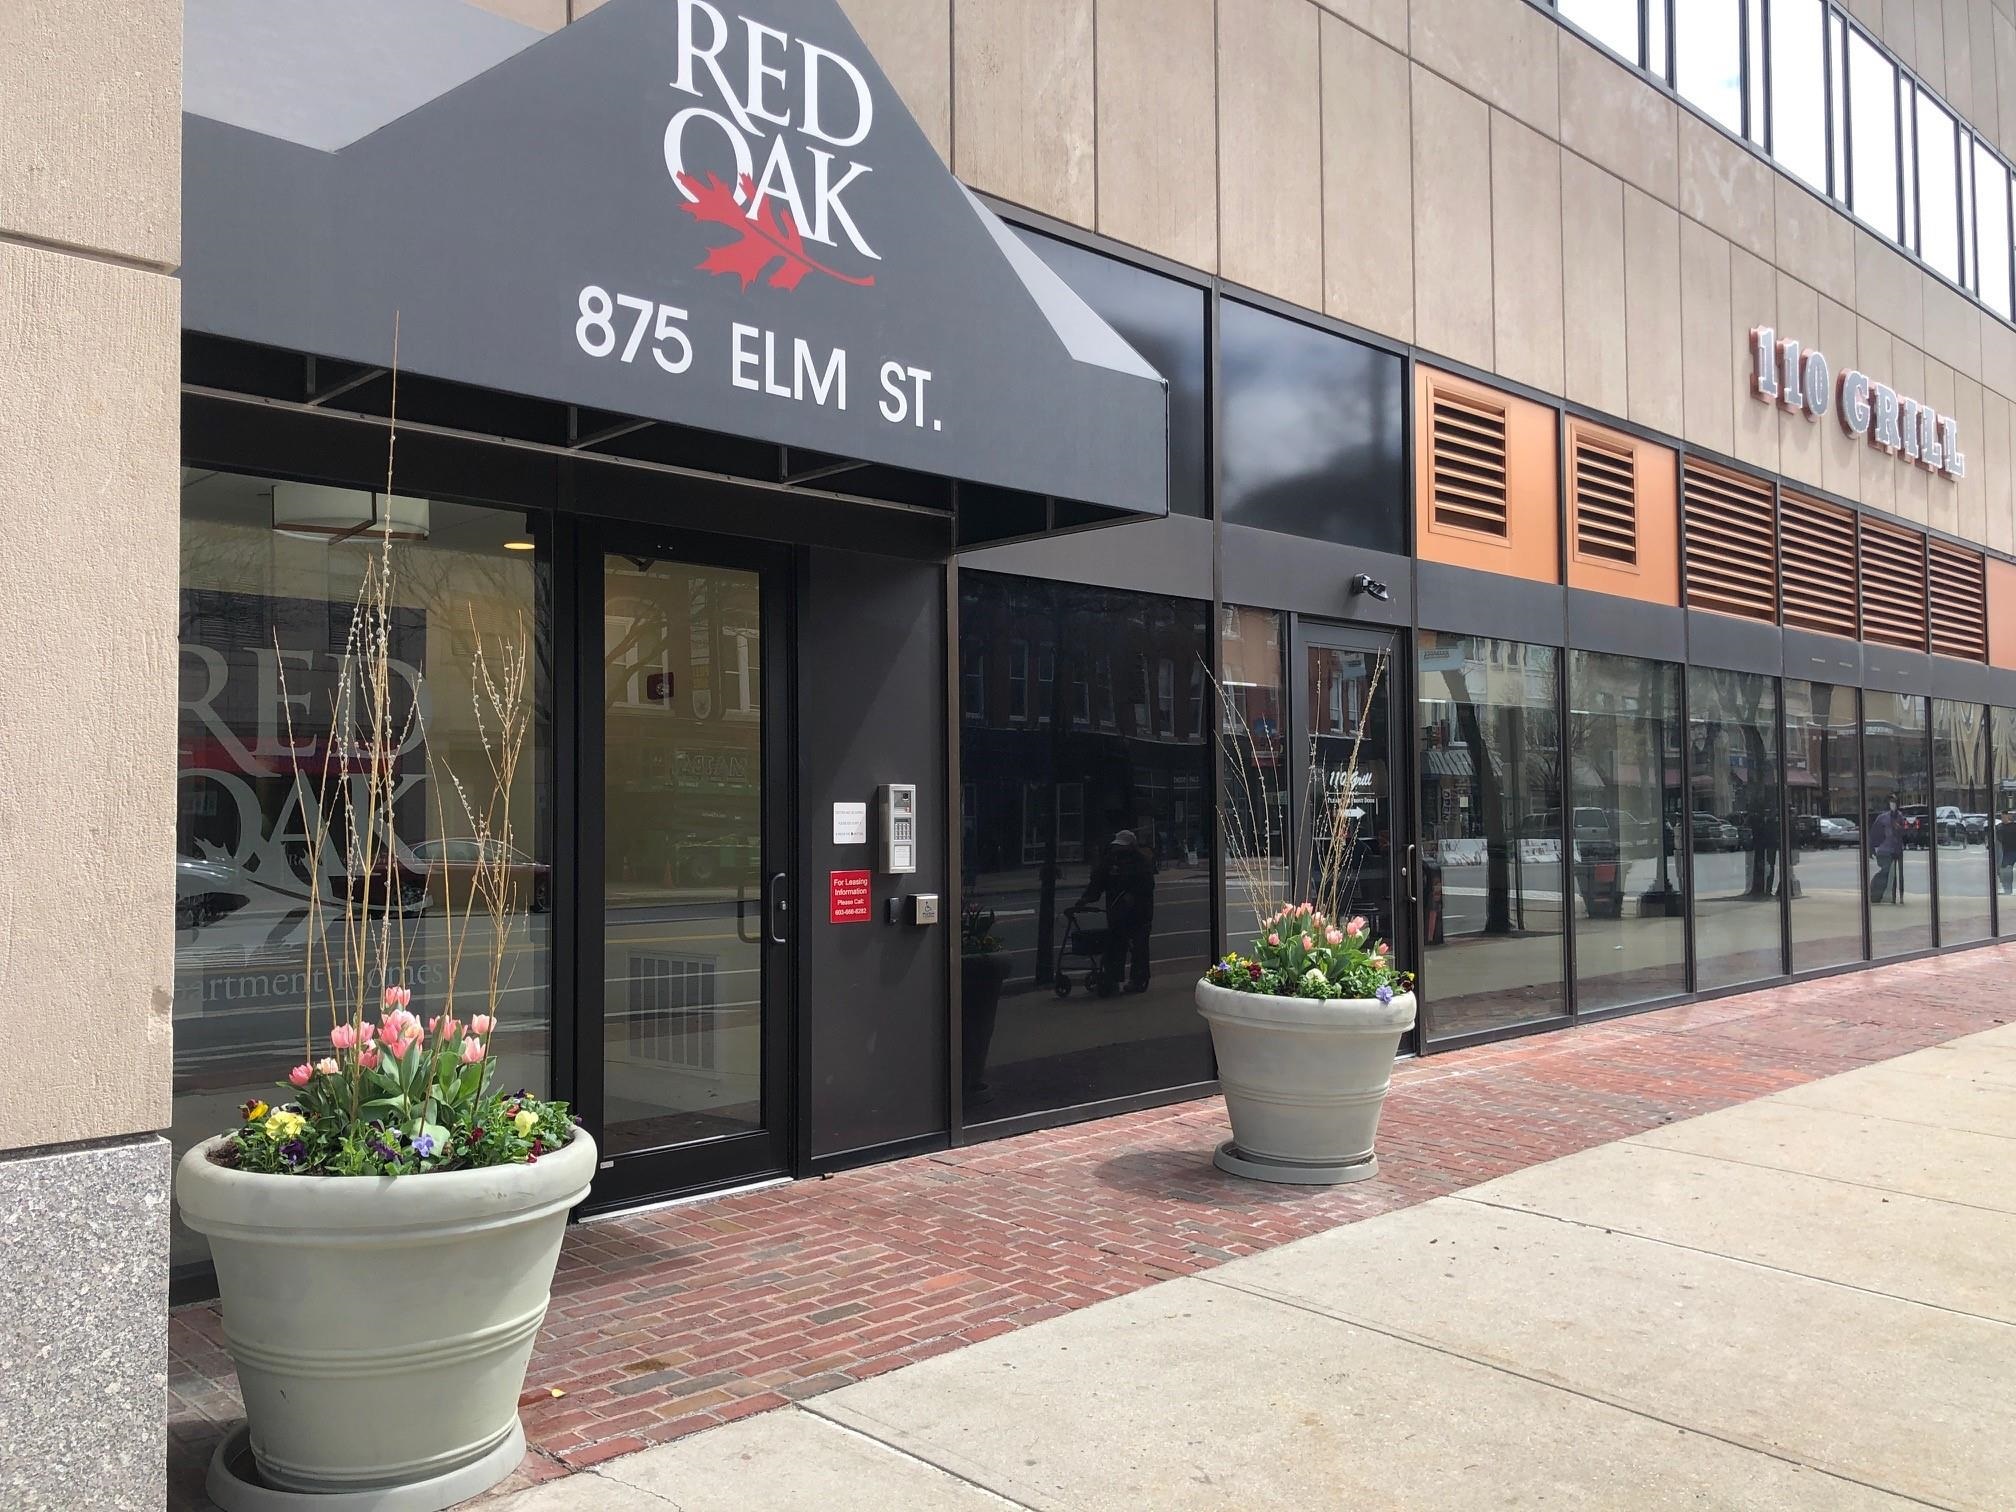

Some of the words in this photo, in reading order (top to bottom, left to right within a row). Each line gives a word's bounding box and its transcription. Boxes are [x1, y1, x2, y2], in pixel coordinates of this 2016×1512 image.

[669, 0, 873, 147] RED
[664, 107, 882, 260] OAK
[576, 286, 693, 375] 875
[732, 322, 847, 410] ELM
[879, 360, 943, 432] ST.
[1750, 325, 1830, 422] 110
[1836, 368, 1965, 482] GRILL
[834, 879, 844, 887] For
[845, 878, 868, 887] Leasing
[835, 888, 867, 896] Information
